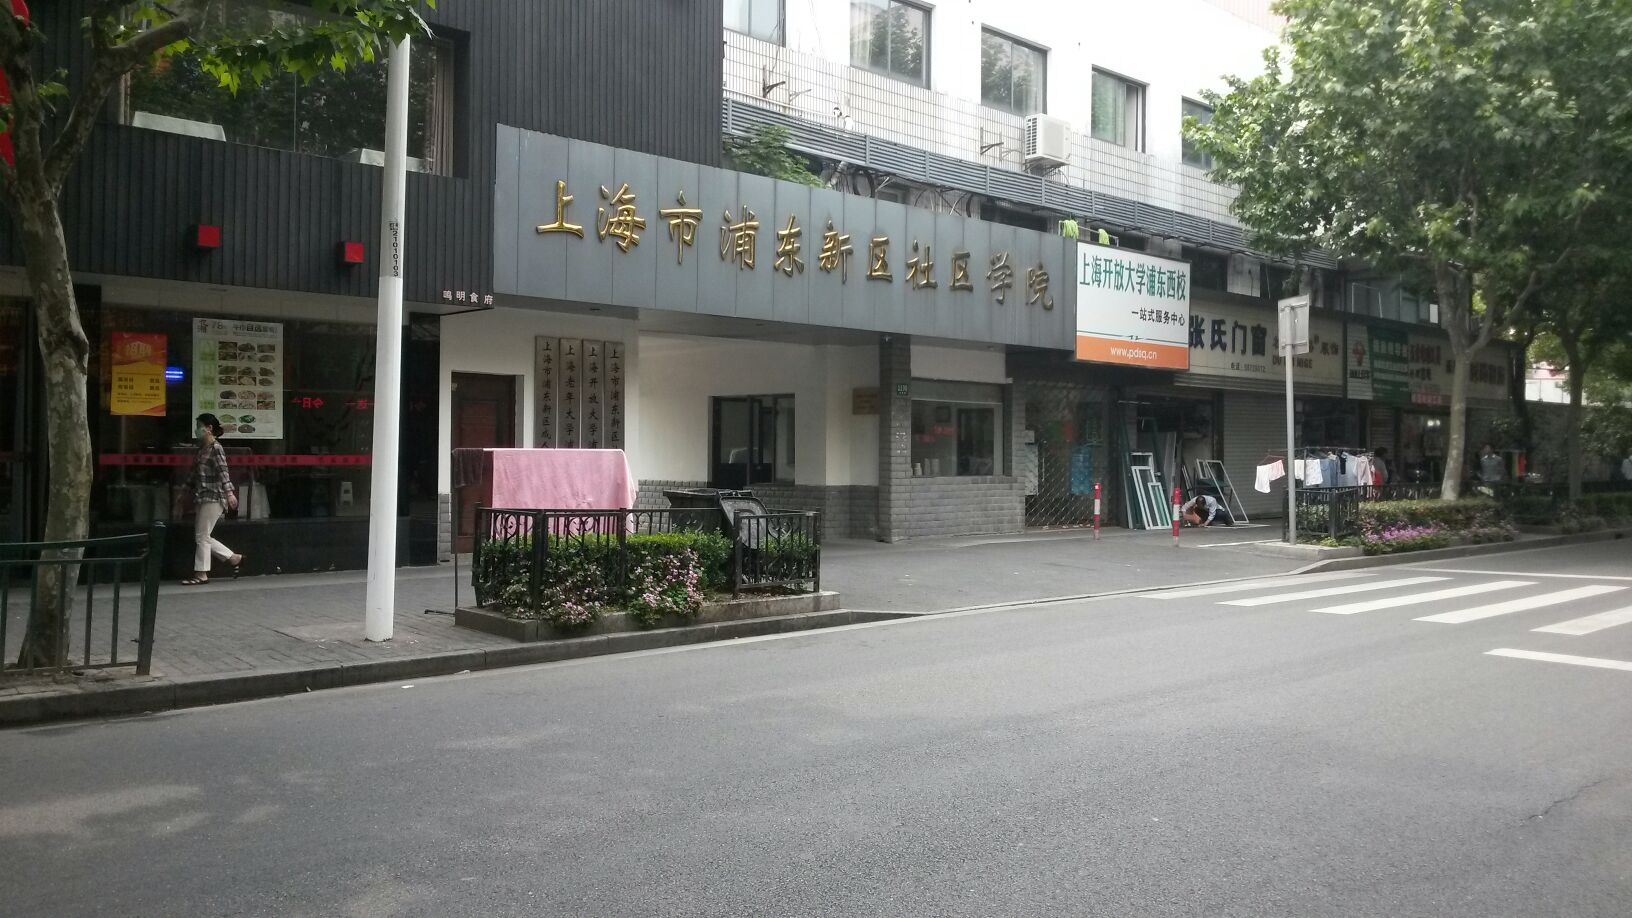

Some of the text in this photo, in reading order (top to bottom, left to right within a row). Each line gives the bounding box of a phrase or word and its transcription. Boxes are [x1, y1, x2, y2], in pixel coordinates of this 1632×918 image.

[535, 179, 1055, 311] 上海市浦东新区社区学院
[442, 290, 494, 305] 鸣明食府
[1079, 252, 1187, 302] 上海开放大学浦东西校
[1131, 307, 1186, 326] 一站式服务中心
[1189, 314, 1268, 356] 张氏门窗
[1110, 345, 1158, 360] www.pdsq.cn
[610, 348, 621, 449] 上海市浦东新区
